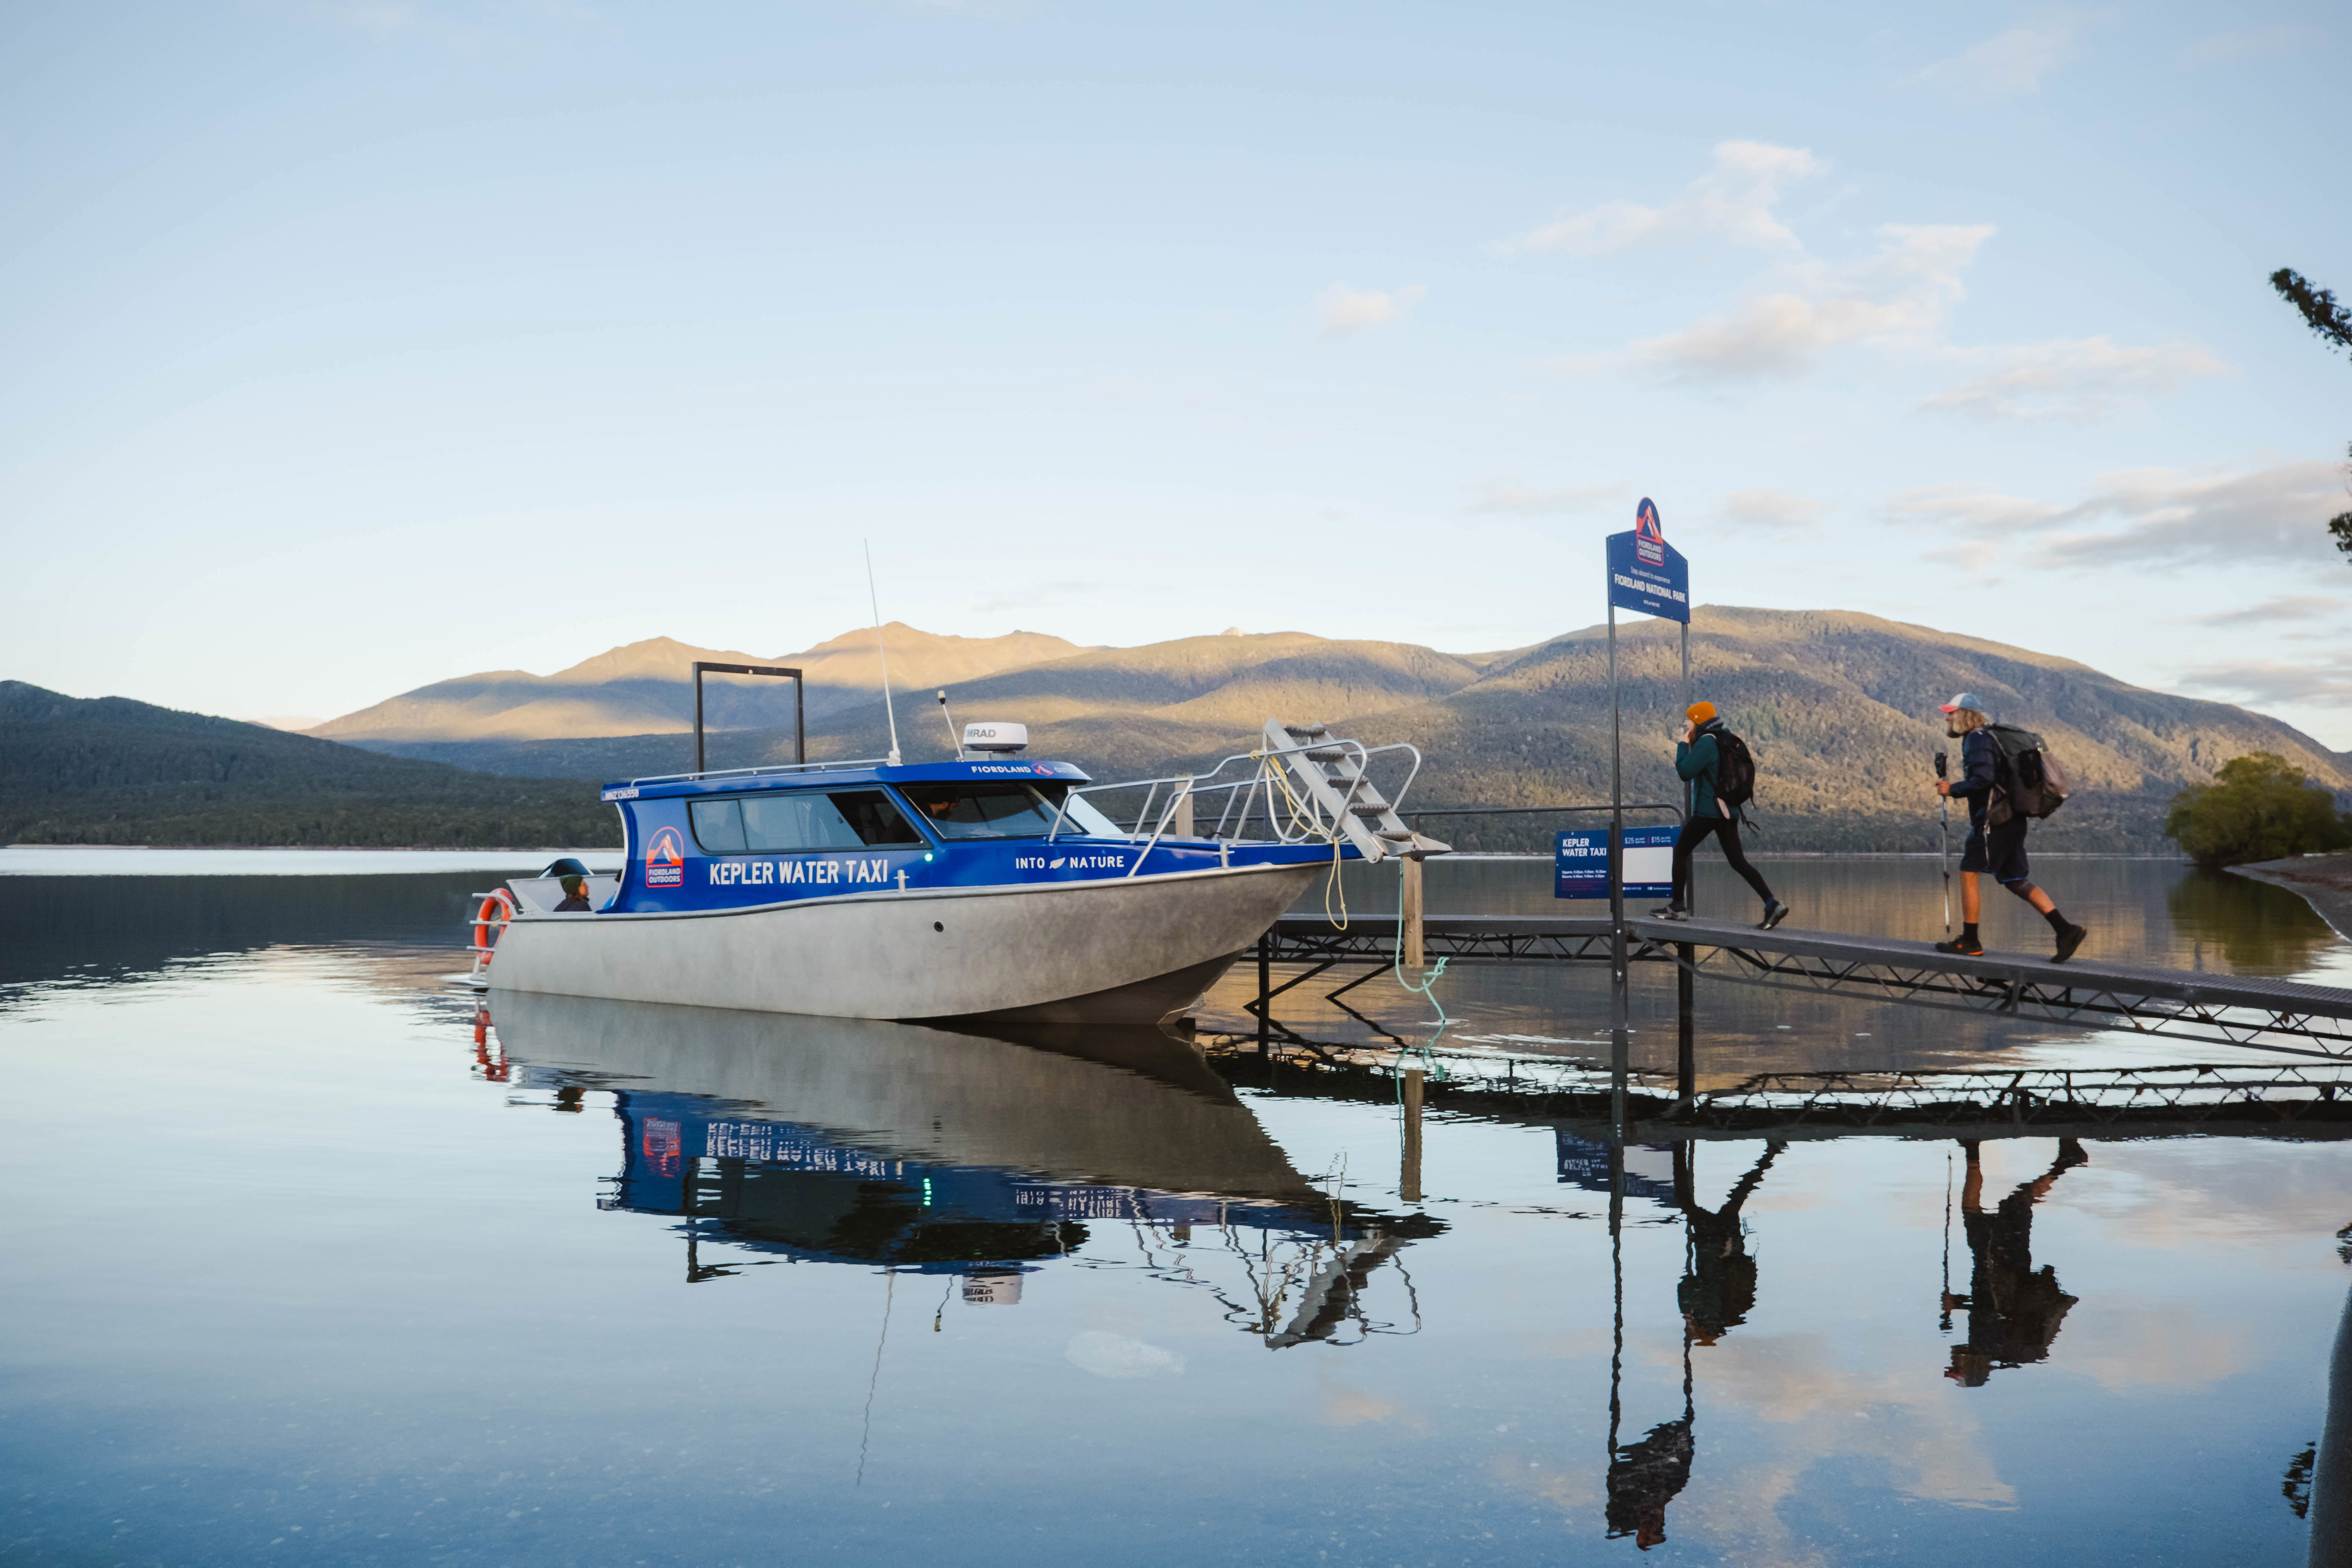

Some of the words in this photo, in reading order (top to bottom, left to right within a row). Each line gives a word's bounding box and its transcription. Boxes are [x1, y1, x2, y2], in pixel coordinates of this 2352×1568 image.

[1638, 539, 1662, 553] FIORDLAND
[1638, 548, 1662, 561] OUTDOORS
[1614, 573, 1645, 591] FIORDLAND
[1646, 582, 1672, 599] NATIONAL
[1672, 590, 1686, 603] PARK
[1563, 838, 1589, 847] KEPLER
[1562, 848, 1588, 857] WATER
[1589, 847, 1607, 856] TAXI
[1016, 857, 1045, 869] INTO
[1070, 856, 1124, 868] NATURE
[648, 868, 681, 876] FIORDLAND
[710, 862, 773, 885] KEPLER
[779, 861, 840, 884] WATER
[845, 859, 888, 884] TAXI
